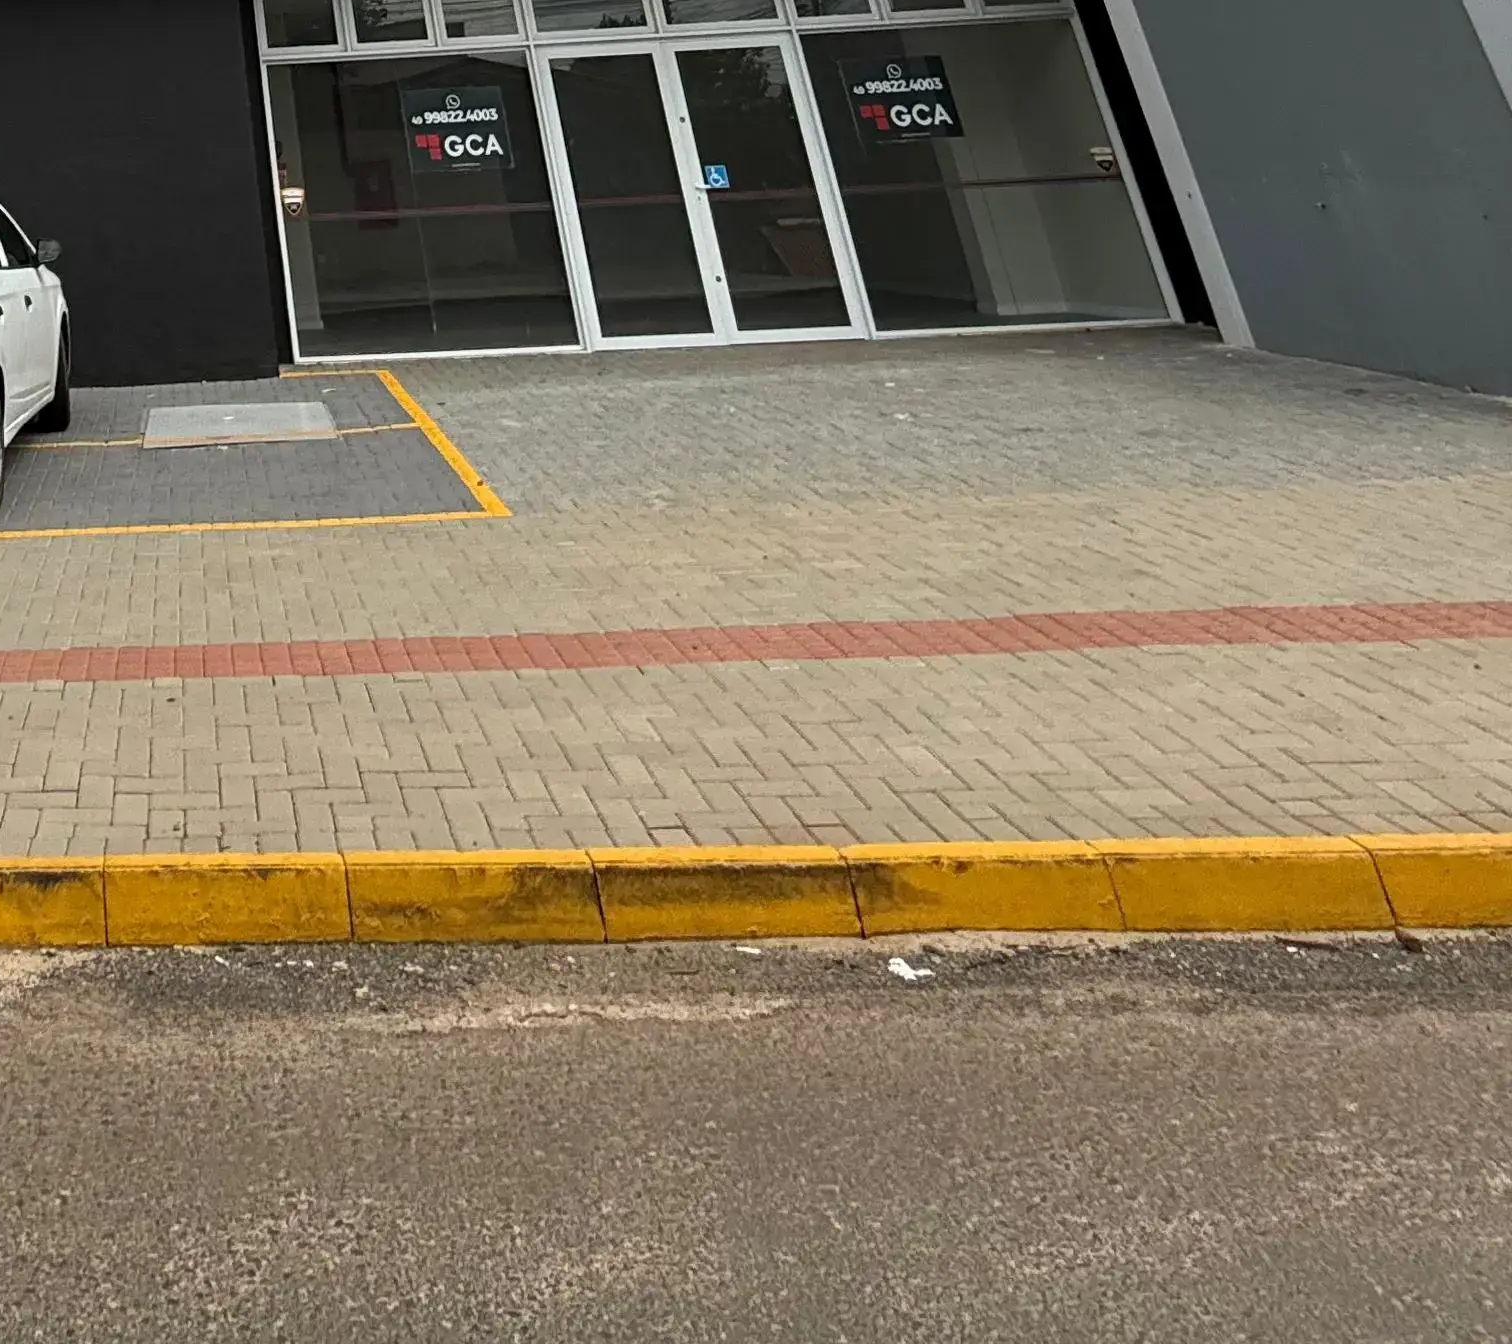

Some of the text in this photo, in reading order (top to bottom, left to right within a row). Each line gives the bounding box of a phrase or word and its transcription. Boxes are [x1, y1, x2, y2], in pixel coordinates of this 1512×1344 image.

[865, 77, 944, 94] 99822.4003
[424, 108, 499, 124] 99822.4003
[890, 103, 954, 127] GCA
[444, 133, 504, 157] GCA
